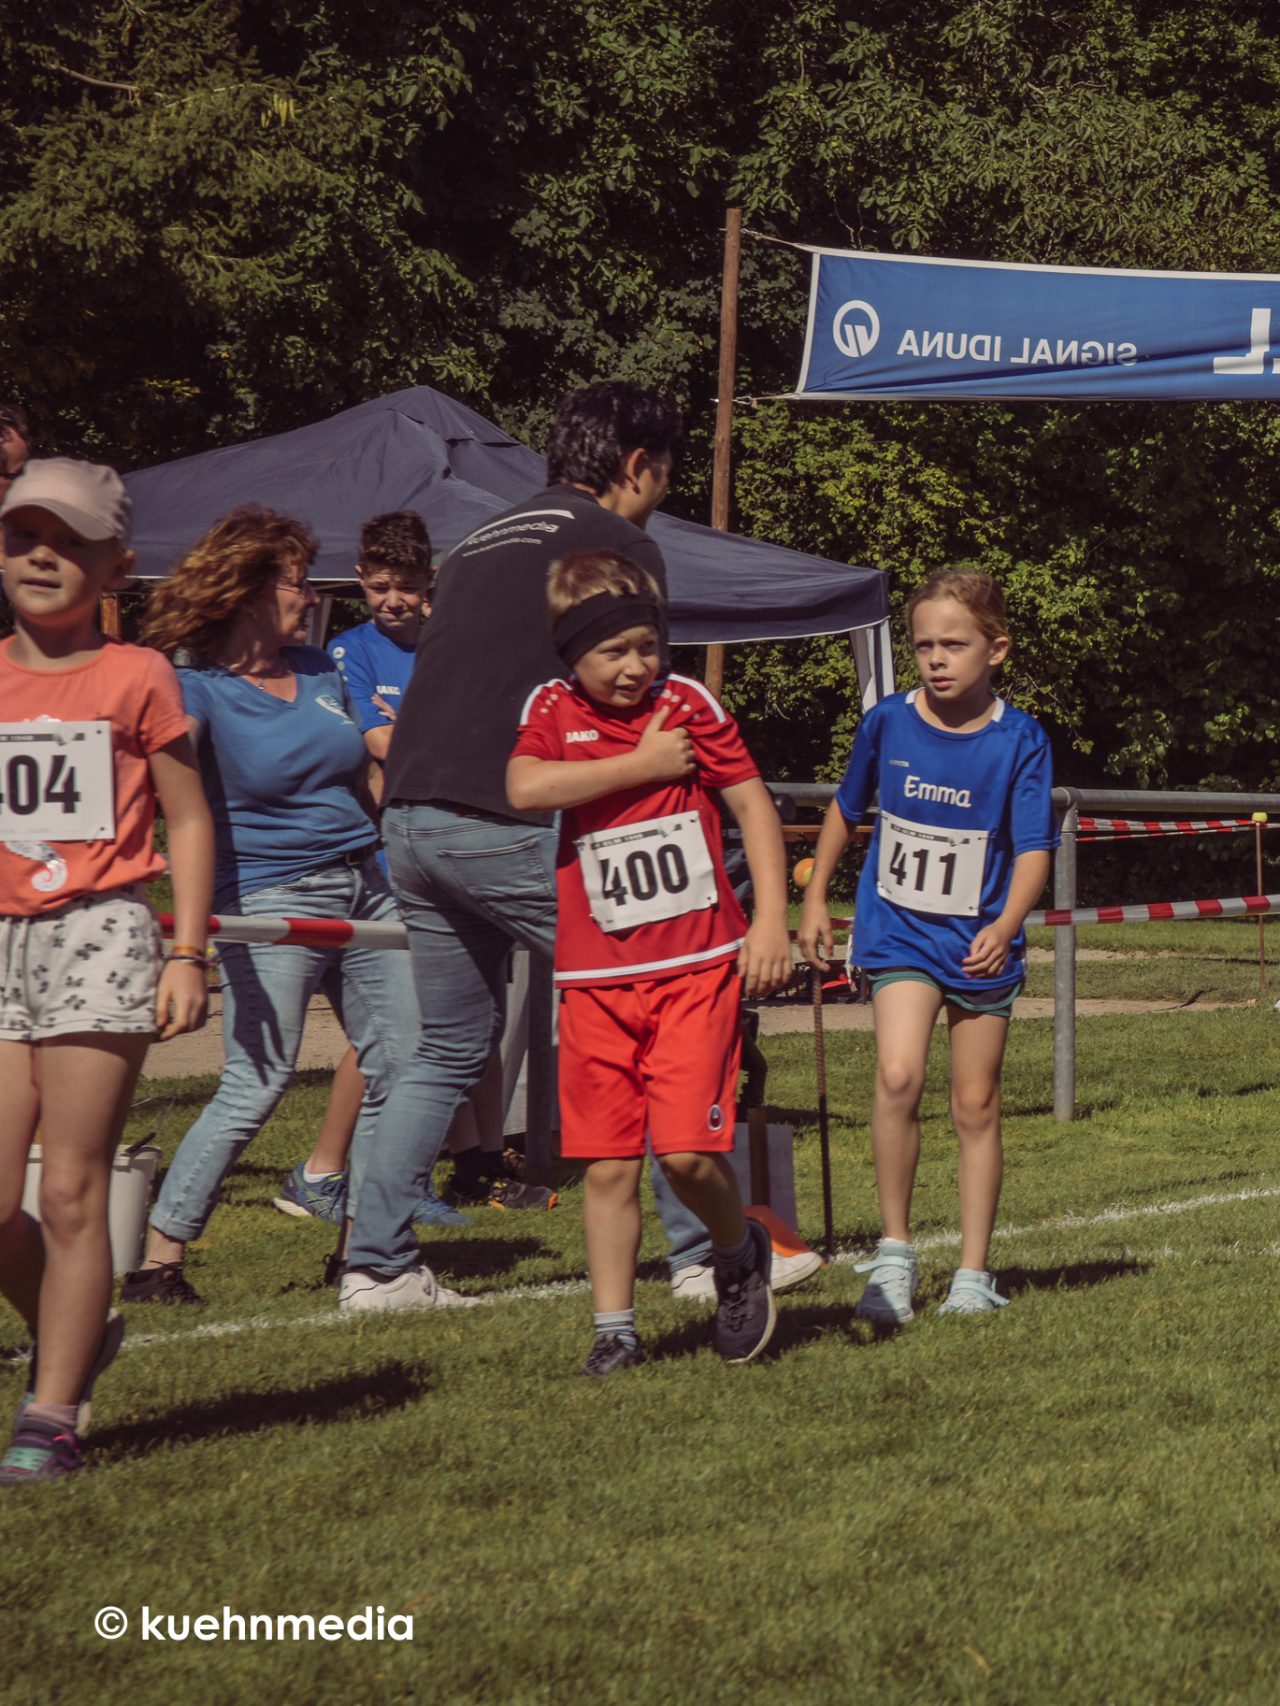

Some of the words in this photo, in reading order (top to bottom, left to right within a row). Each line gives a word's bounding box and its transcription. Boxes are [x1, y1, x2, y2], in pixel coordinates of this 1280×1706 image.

[0, 754, 81, 816] 04
[904, 775, 972, 808] Emma
[599, 843, 690, 907] 400
[889, 841, 957, 896] 411
